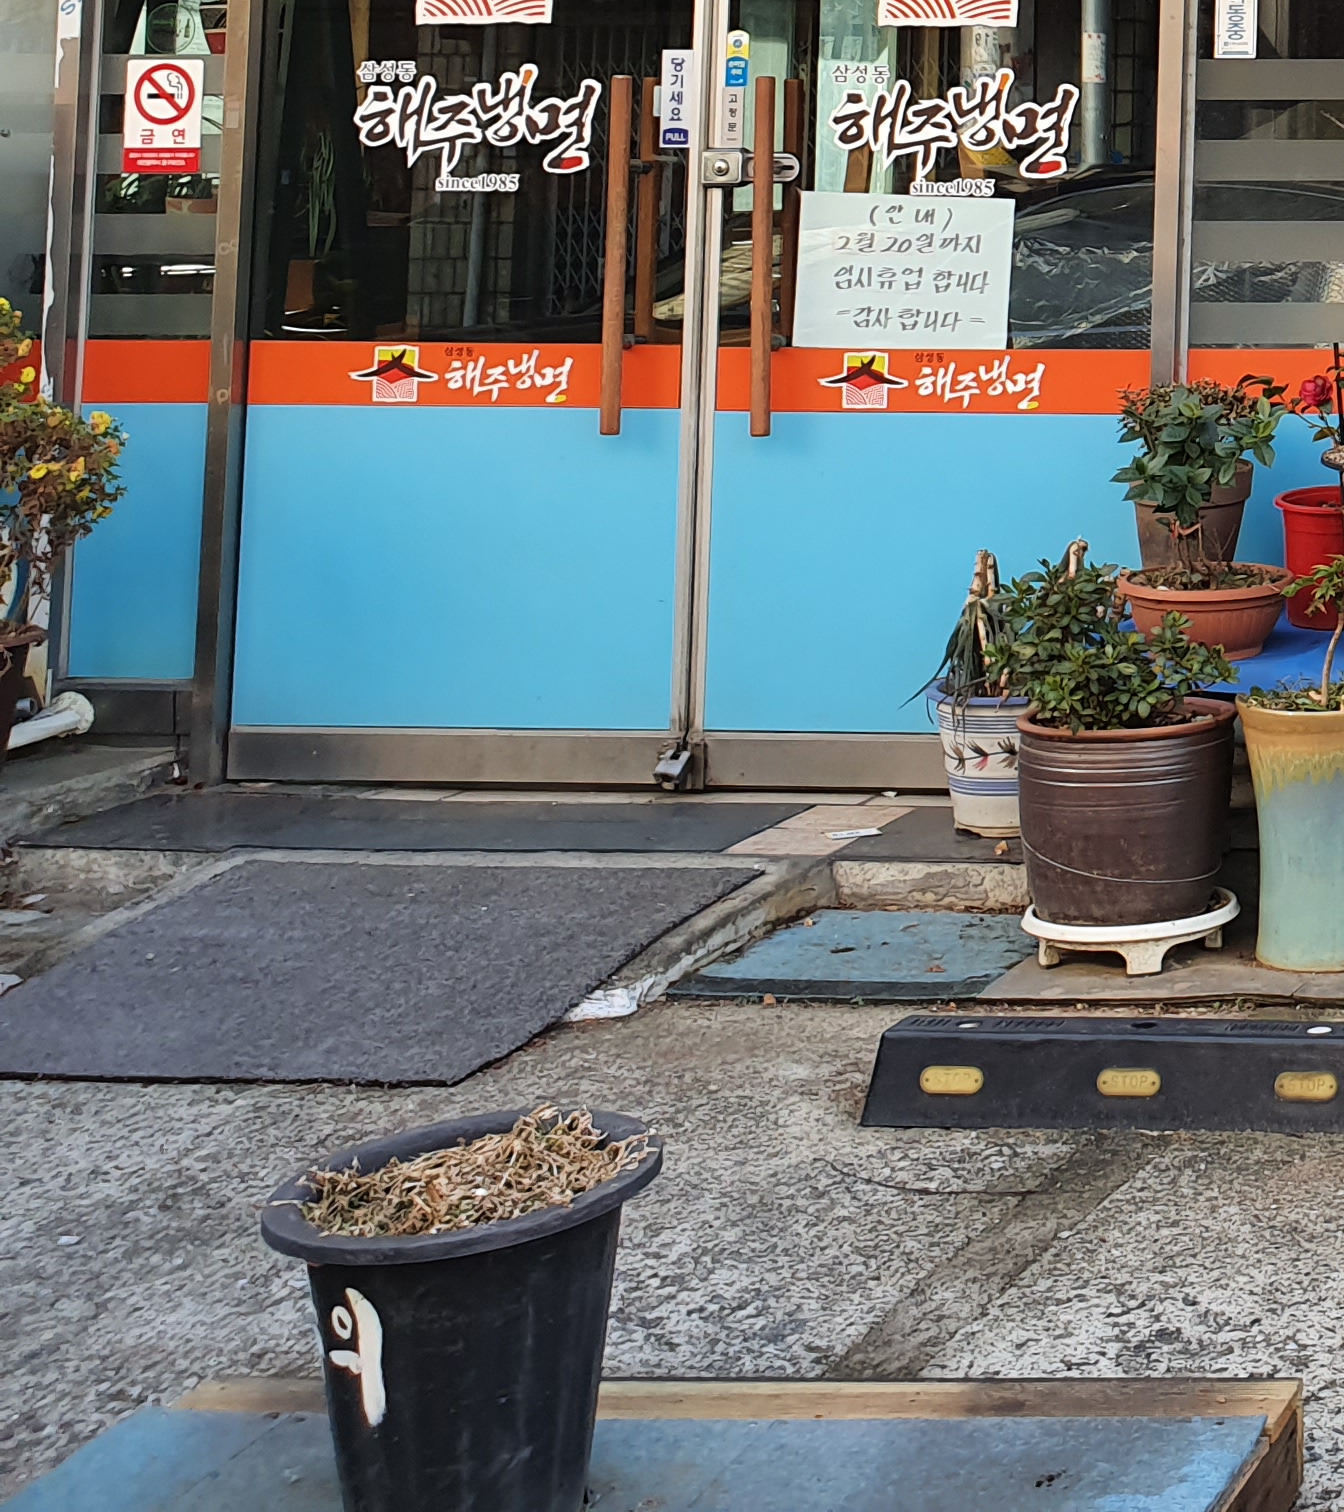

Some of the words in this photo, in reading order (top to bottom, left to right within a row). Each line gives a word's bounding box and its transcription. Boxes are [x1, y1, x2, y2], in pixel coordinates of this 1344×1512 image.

[359, 61, 417, 82] 삼성동
[832, 64, 890, 84] 삼성동
[669, 57, 686, 122] 당기세요
[356, 66, 599, 174] 해주냉면
[831, 71, 1077, 176] 해주냉면
[140, 128, 186, 145] 금연
[665, 132, 687, 142] PULL
[437, 175, 519, 192] since1985
[912, 178, 995, 196] since1985
[932, 269, 990, 295] 합니다
[445, 349, 574, 404] 해주냉면
[915, 355, 1046, 410] 해주냉면
